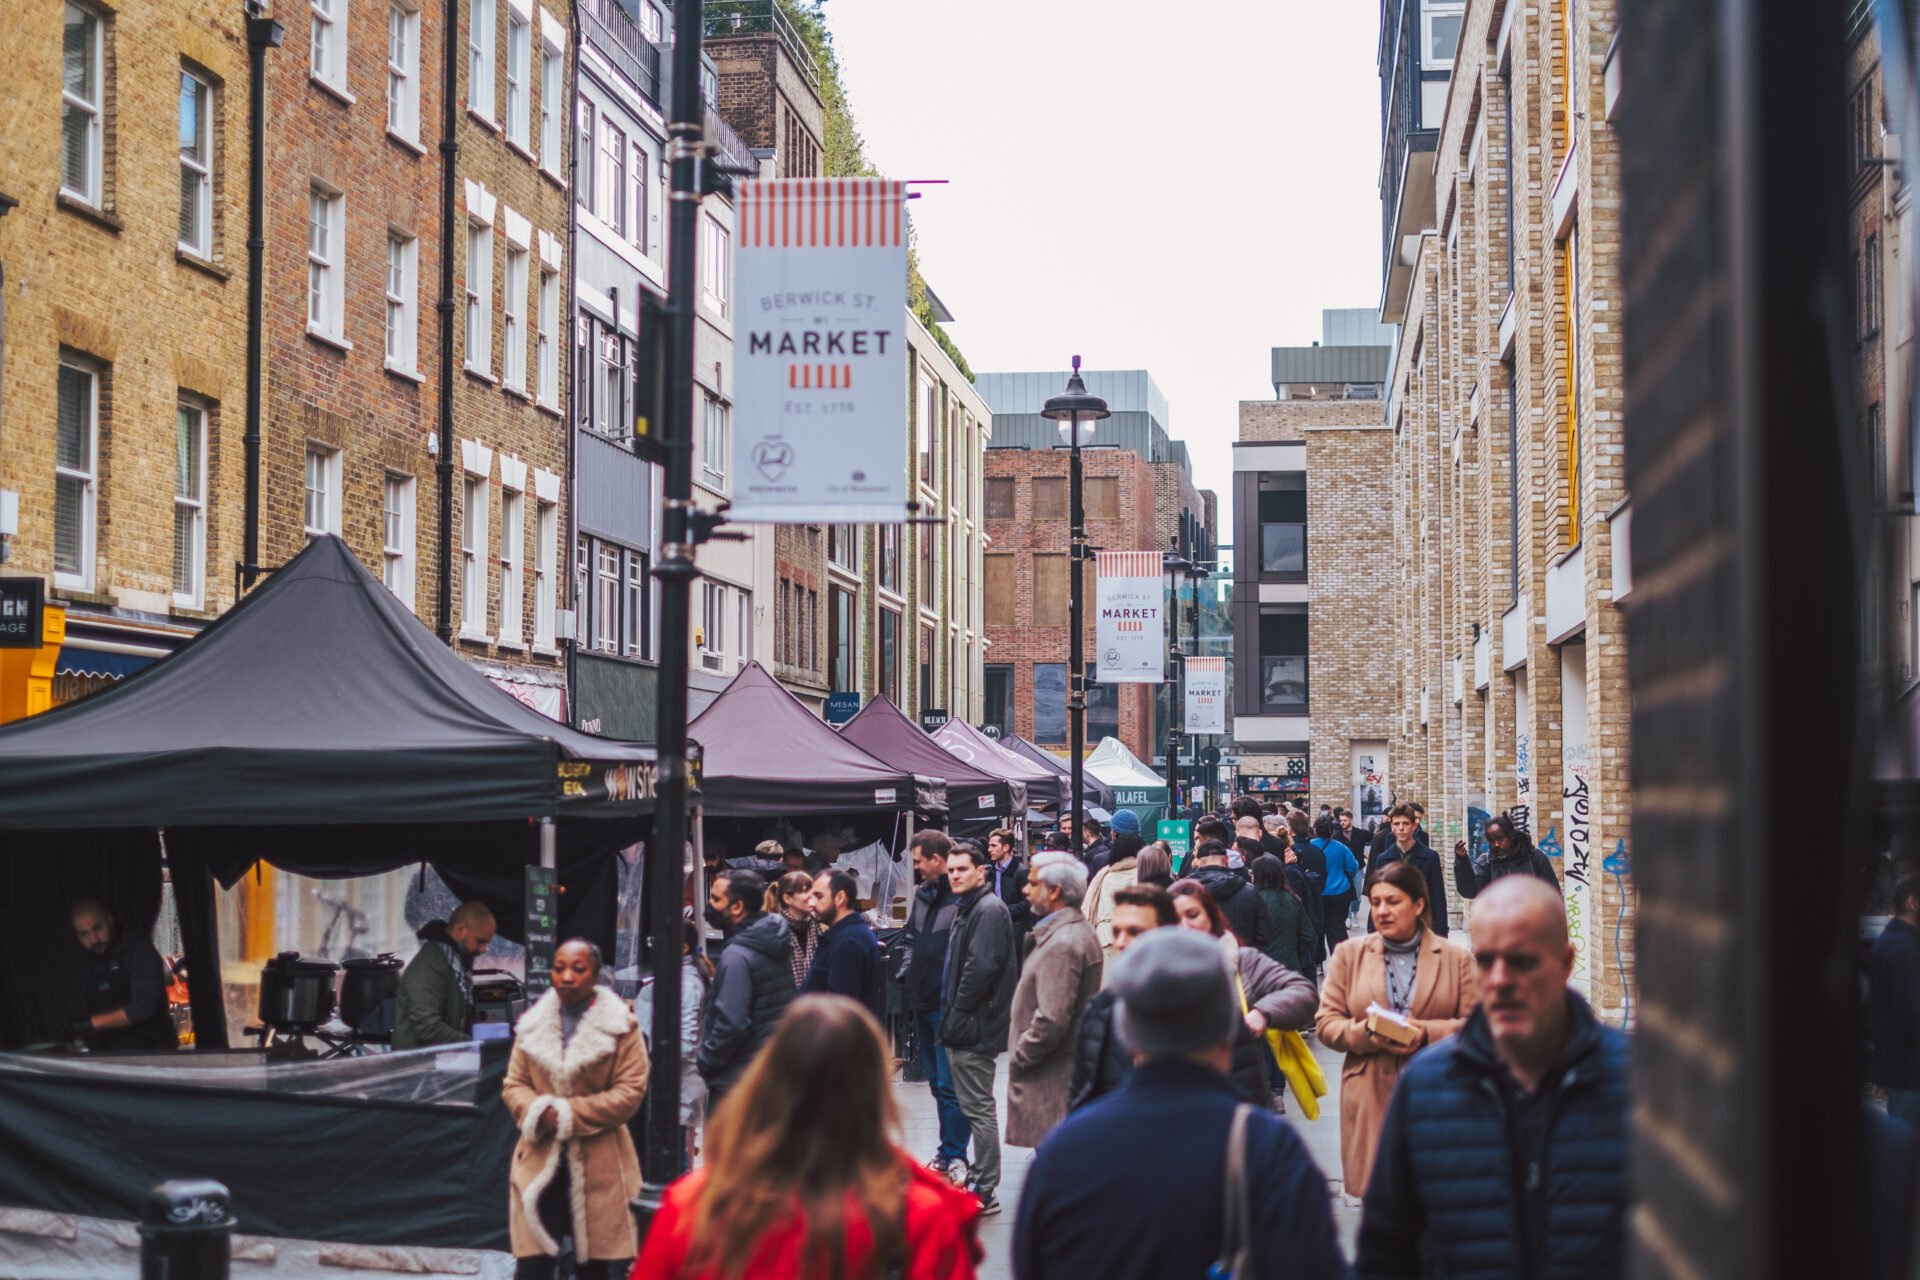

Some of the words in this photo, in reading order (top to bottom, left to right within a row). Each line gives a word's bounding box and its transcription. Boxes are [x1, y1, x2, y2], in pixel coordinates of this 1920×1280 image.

[761, 291, 845, 311] BERWICK
[749, 331, 890, 355] MARKET
[1103, 608, 1157, 618] MARKET
[0, 624, 28, 632] AGE
